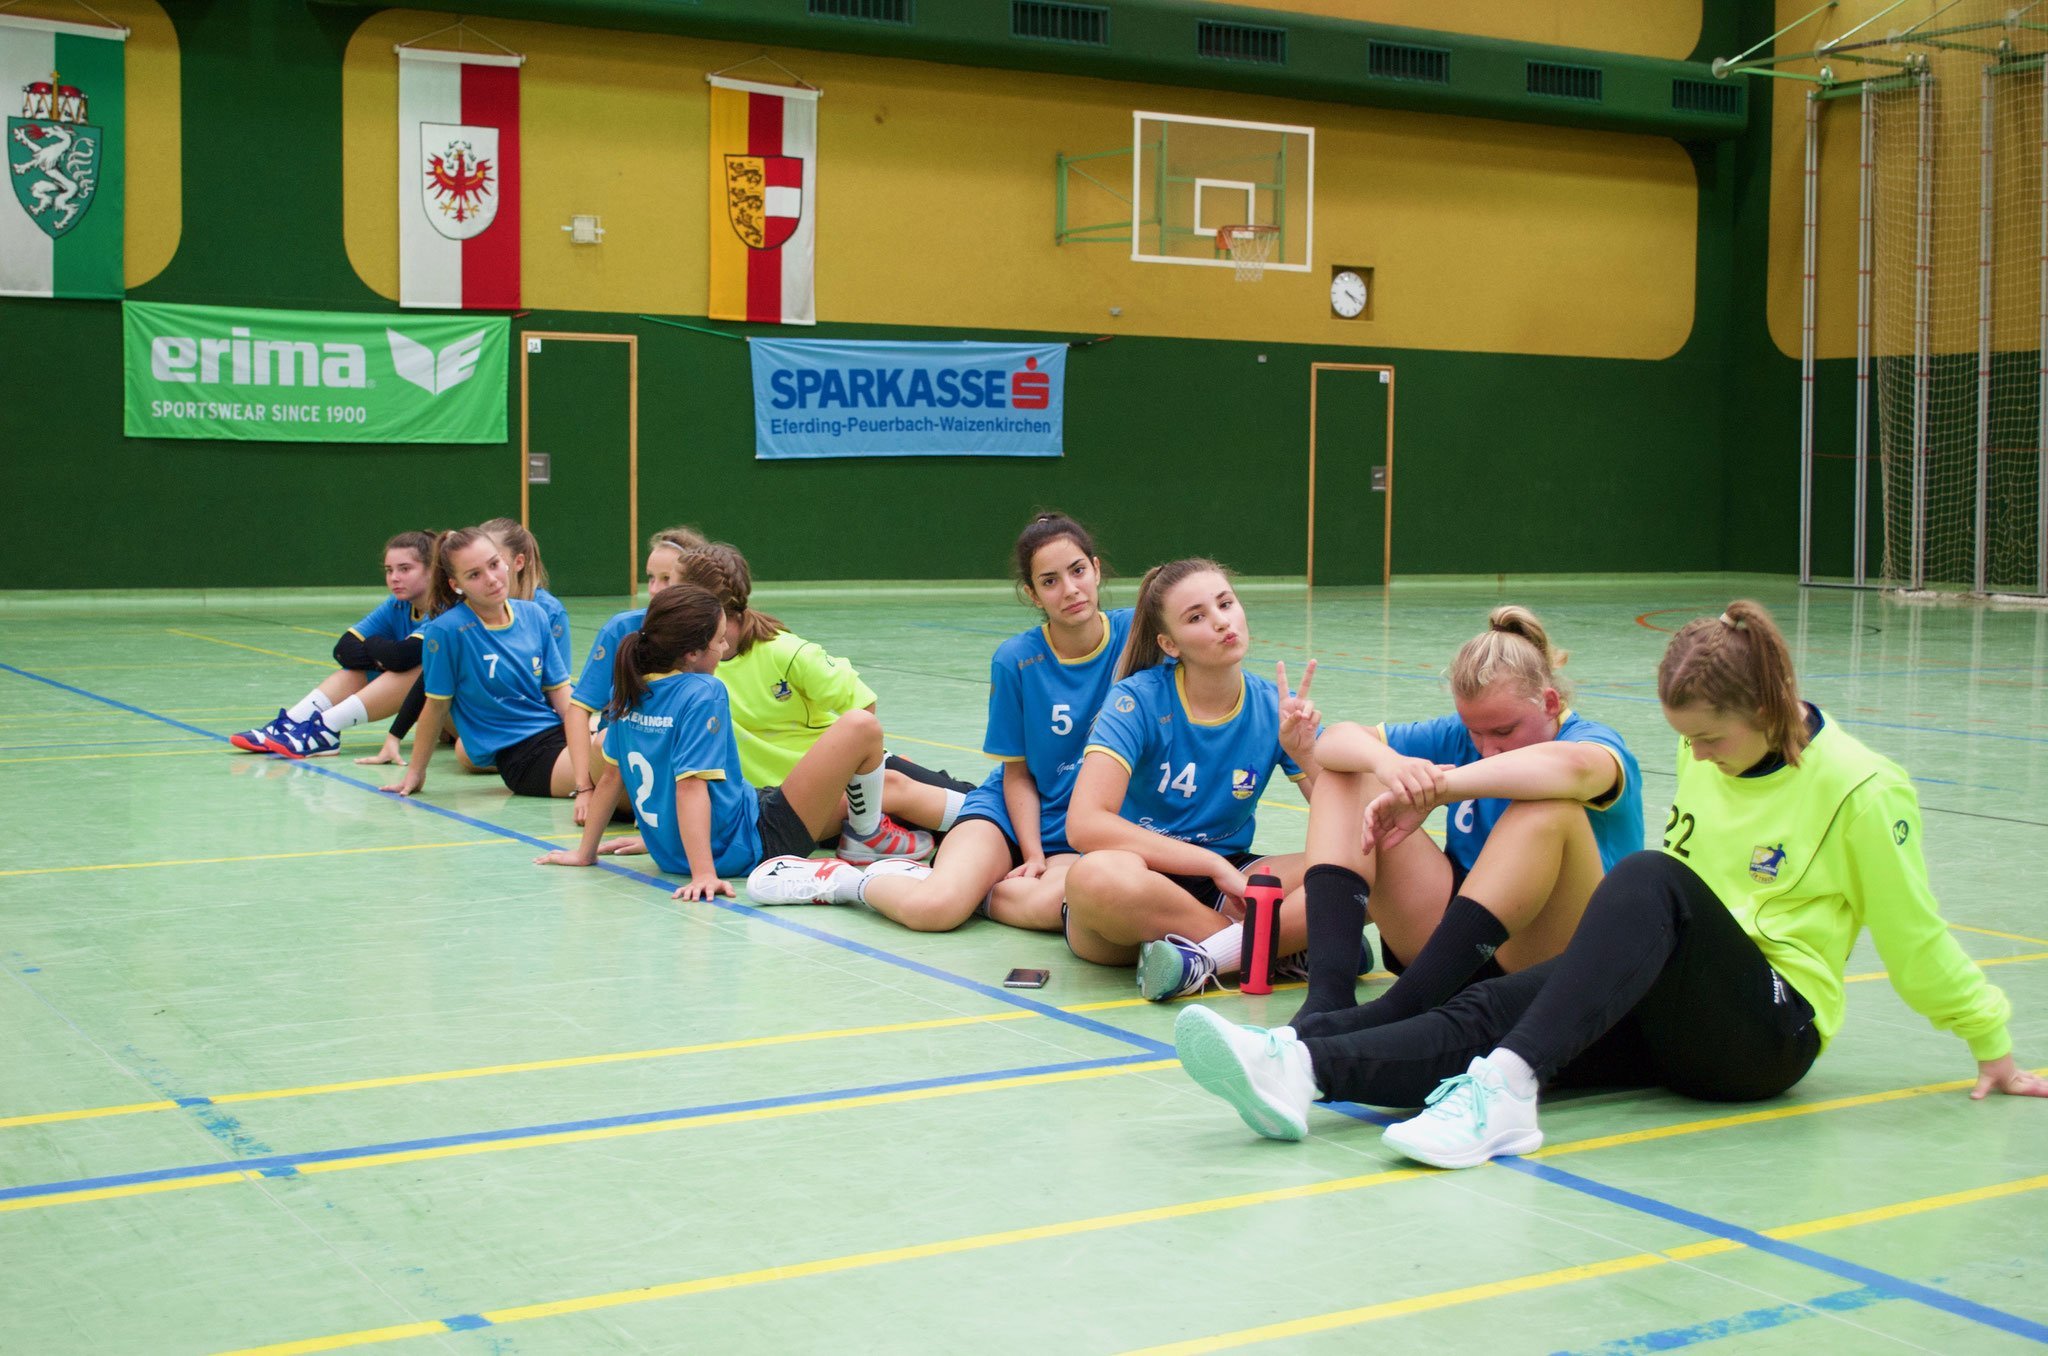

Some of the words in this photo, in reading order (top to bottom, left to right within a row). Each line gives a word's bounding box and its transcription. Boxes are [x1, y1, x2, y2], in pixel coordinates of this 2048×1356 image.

[150, 326, 367, 389] erima
[770, 368, 1007, 410] SPARKASSE
[151, 401, 266, 422] SPORTSWEAR
[271, 405, 321, 423] SINCE
[326, 406, 367, 424] 1900
[771, 415, 1051, 437] Eferding-Peuerbach-Waizenkirchen
[483, 653, 499, 679] 7
[1050, 704, 1074, 736] 5
[627, 750, 659, 828] 2
[1157, 760, 1198, 798] 14
[1454, 799, 1476, 834] 6
[1663, 803, 1696, 859] 22
